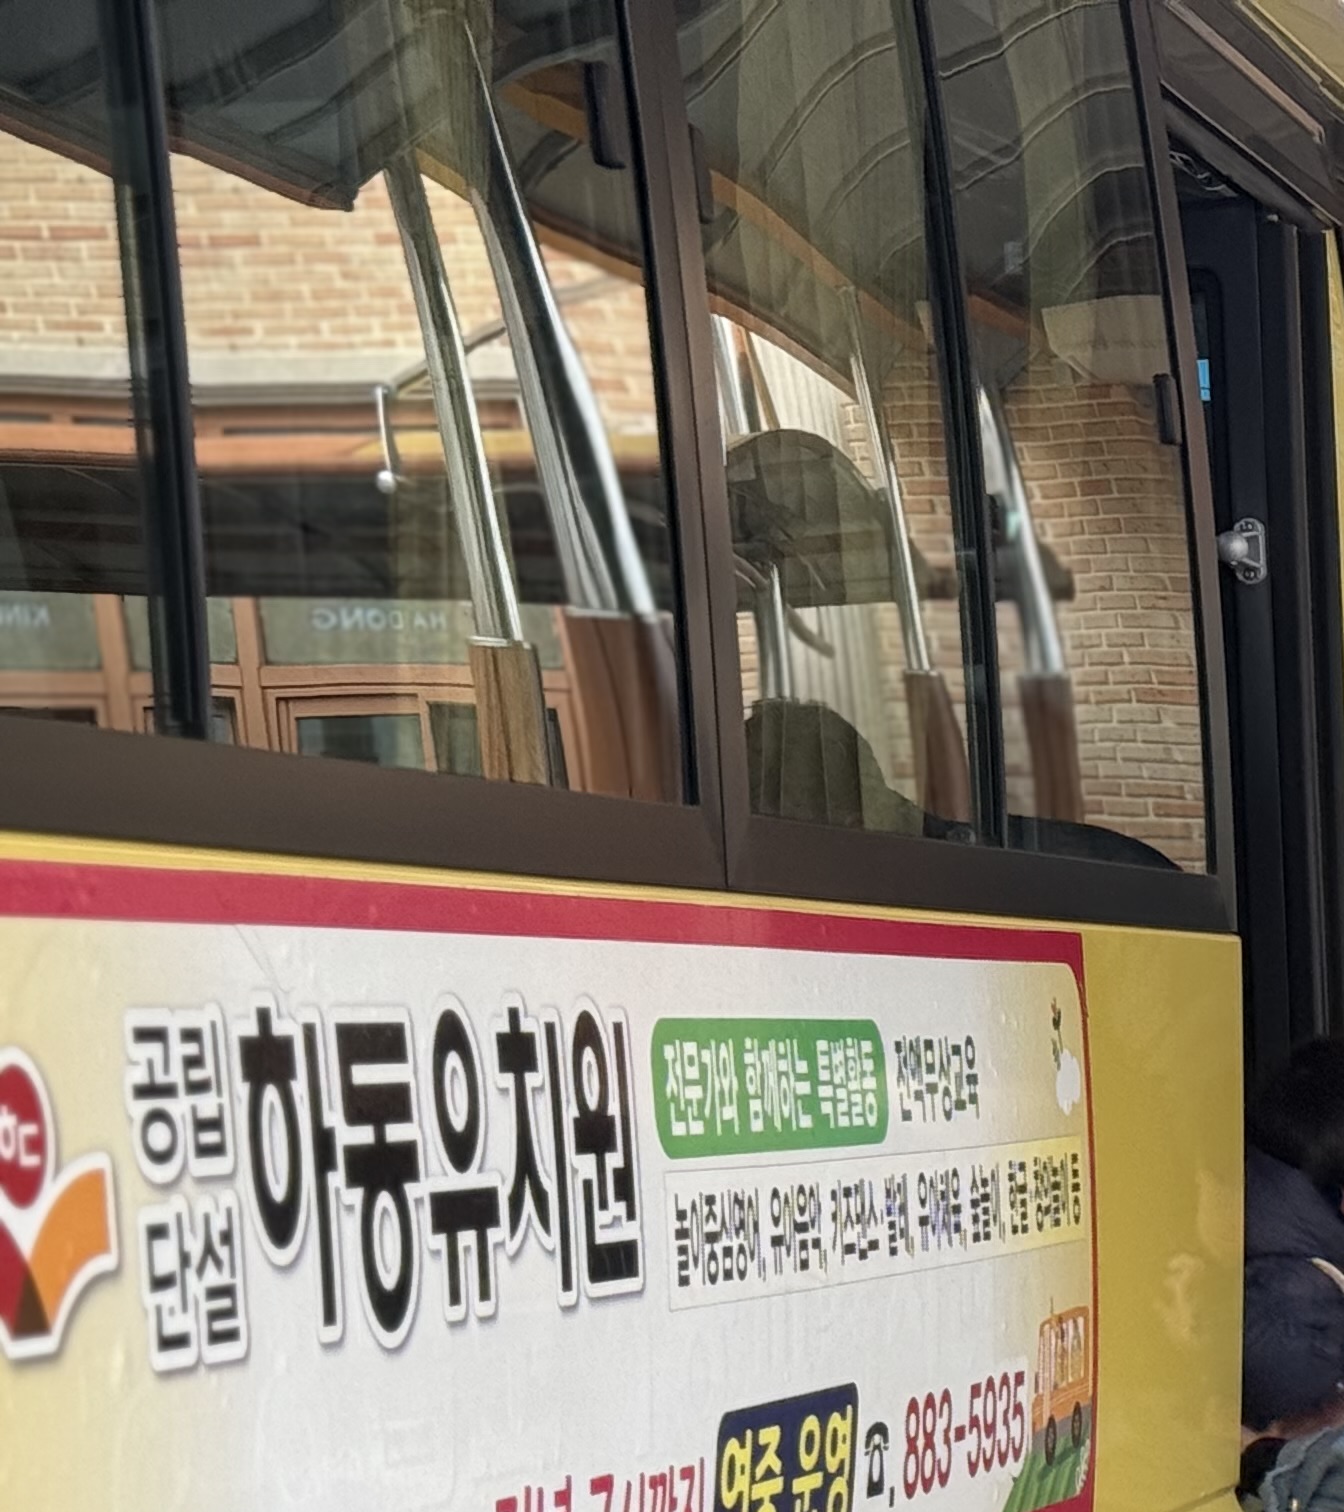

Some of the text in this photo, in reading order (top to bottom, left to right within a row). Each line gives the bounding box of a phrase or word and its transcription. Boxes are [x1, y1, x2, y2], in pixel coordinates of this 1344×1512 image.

[131, 1017, 227, 1168] 공립
[663, 1036, 878, 1136] 전문가와 함께하는 특별활동
[238, 1006, 641, 1334] 하동유치원
[674, 1186, 766, 1287] 놀이중심영어,
[770, 1181, 827, 1276] 유아음악,
[147, 1203, 241, 1355] 단설
[903, 1370, 1026, 1501] 883-5935
